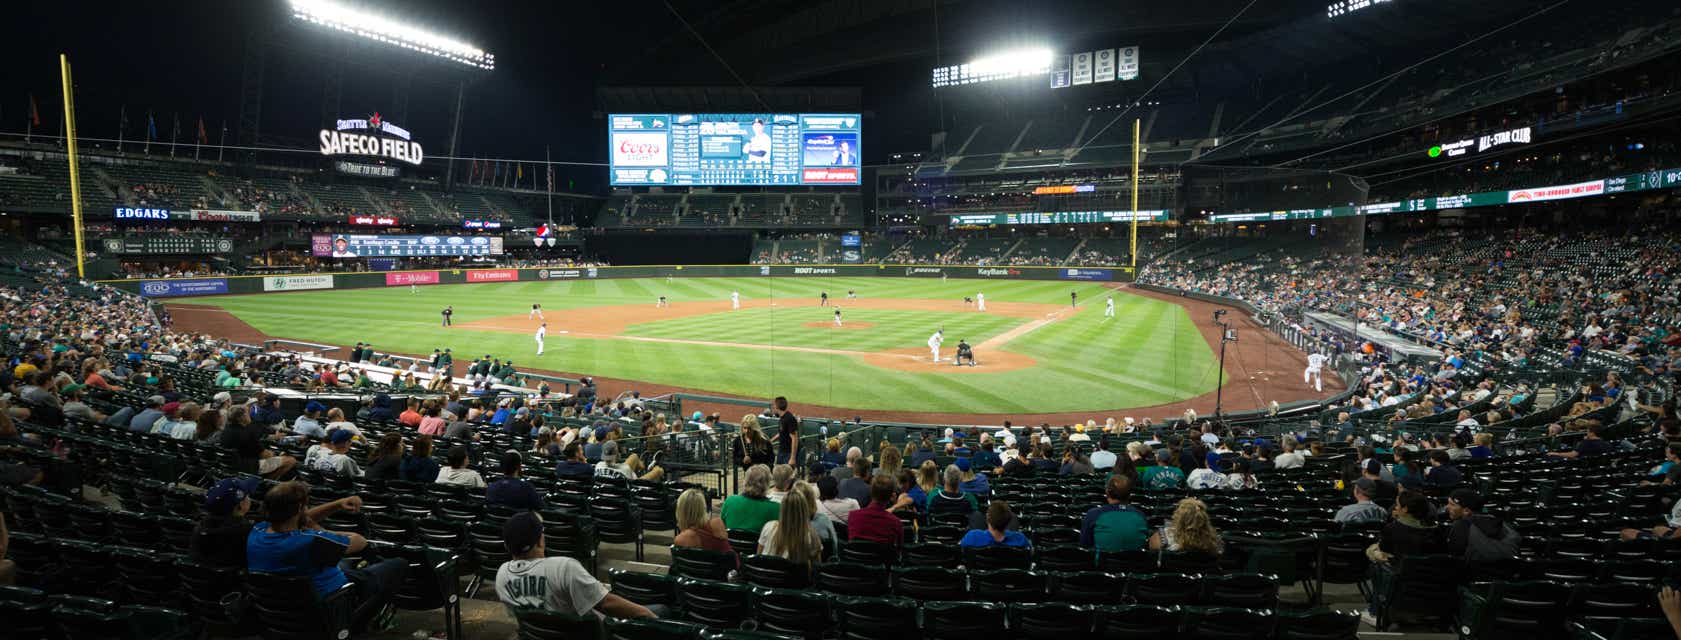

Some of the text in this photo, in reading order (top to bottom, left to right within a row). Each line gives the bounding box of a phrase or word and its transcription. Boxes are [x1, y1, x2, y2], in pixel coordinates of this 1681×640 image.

[1511, 127, 1531, 143] CLUB
[320, 129, 423, 165] SAFECO FIELD
[619, 138, 660, 154] Coors
[116, 208, 168, 220] EDGARS
[485, 271, 512, 279] Emirates
[978, 268, 1008, 276] KeyBank
